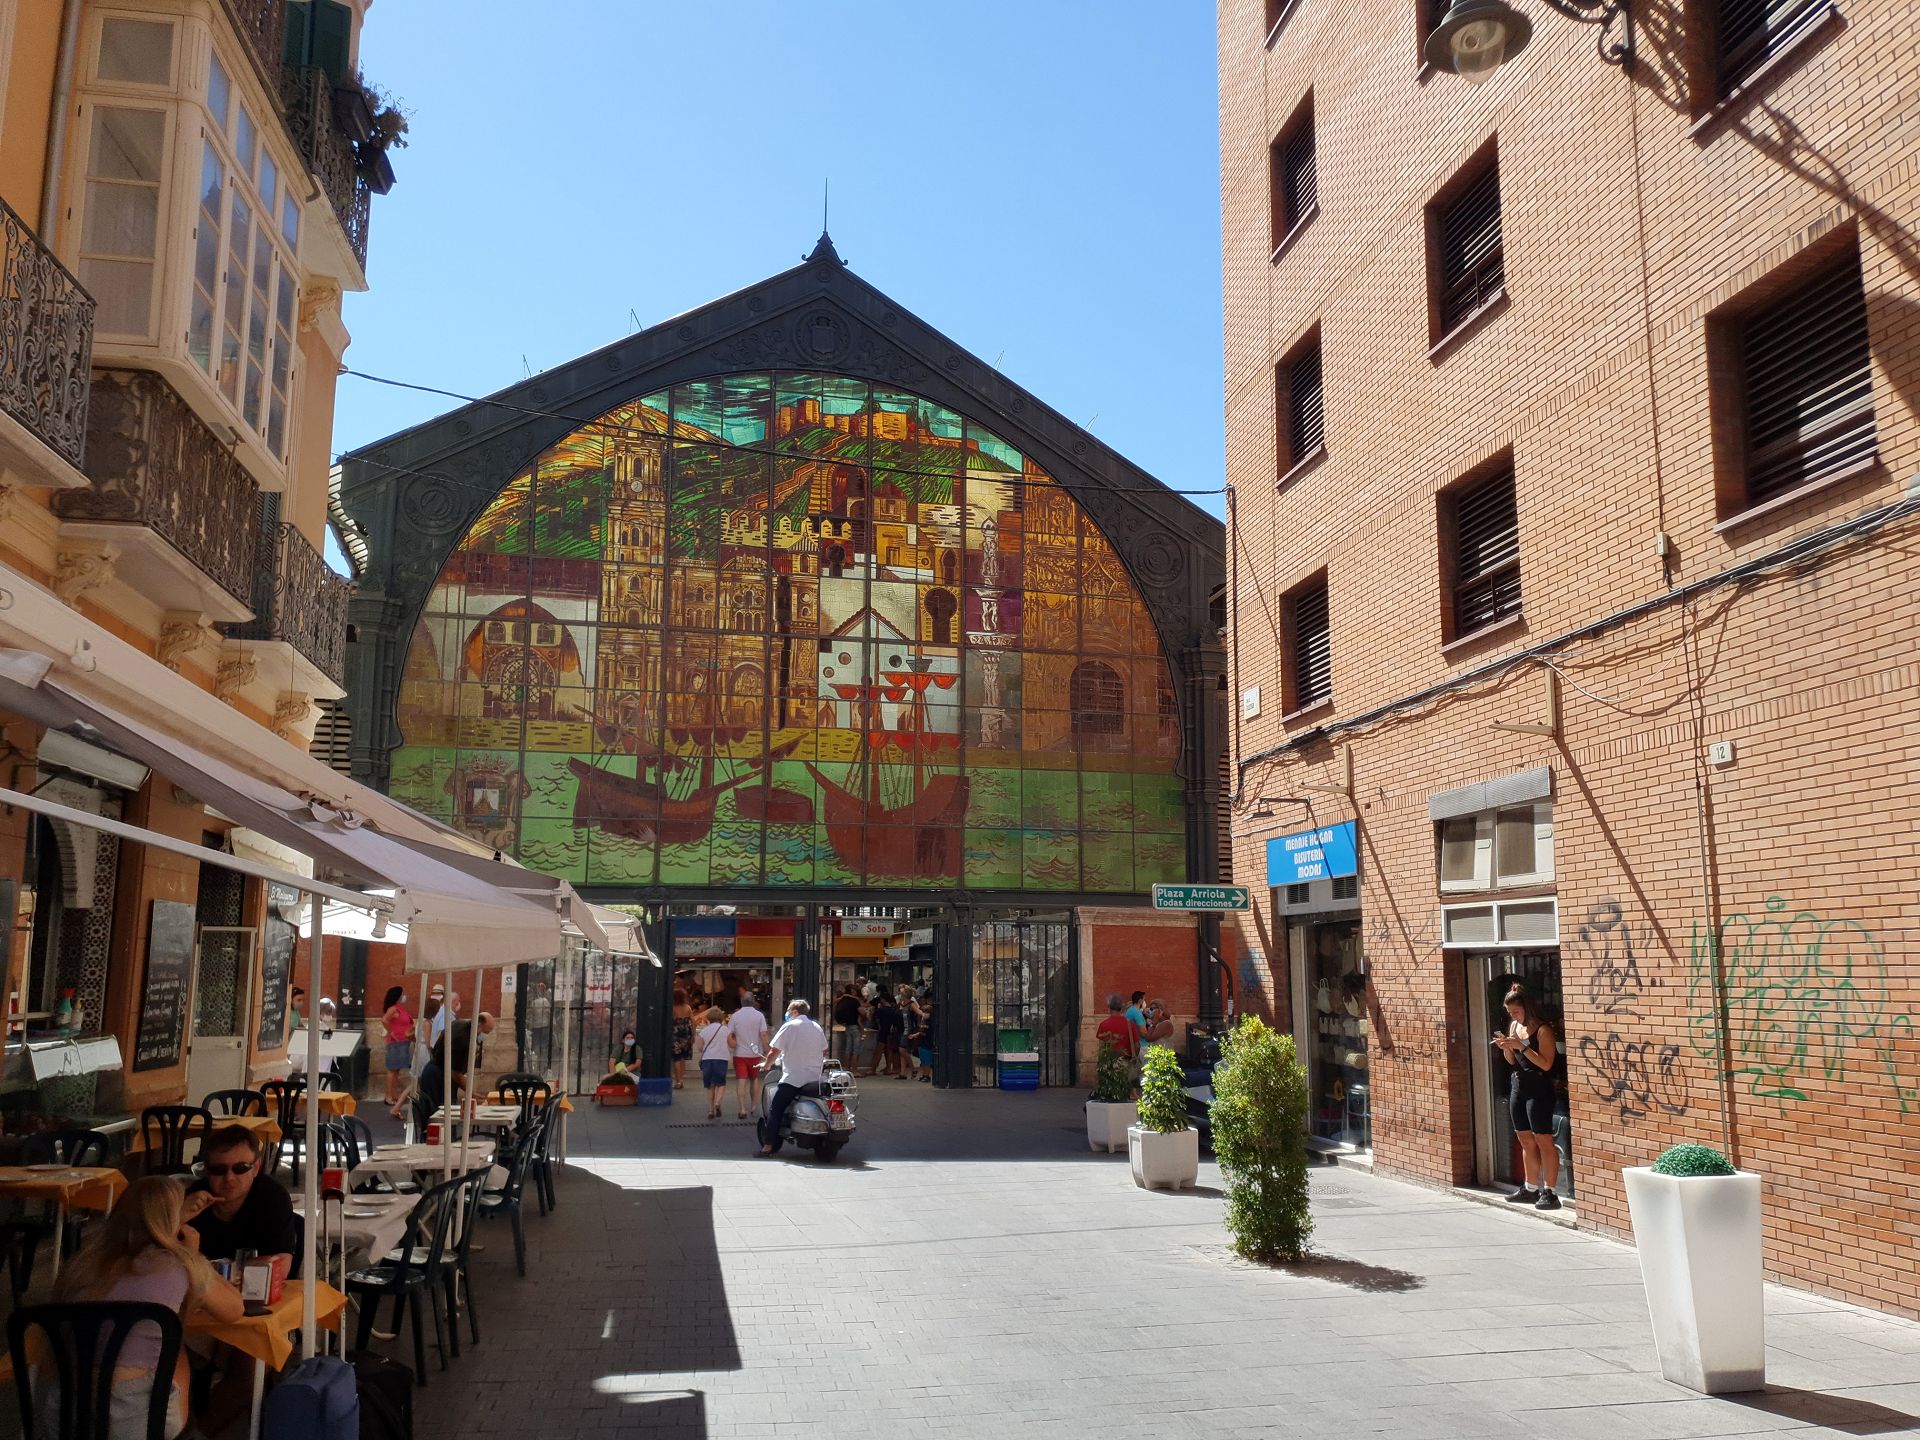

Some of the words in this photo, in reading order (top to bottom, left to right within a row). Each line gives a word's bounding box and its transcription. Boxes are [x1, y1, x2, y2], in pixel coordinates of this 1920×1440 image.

[1716, 746, 1725, 760] 12
[1286, 835, 1309, 851] MENAJE
[1309, 830, 1333, 847] HOGAR
[1297, 863, 1322, 879] MODAS
[1157, 888, 1184, 898] Plaza
[1191, 889, 1226, 899] Arriola
[1158, 898, 1183, 907] Todas
[1185, 899, 1233, 908] direcciones
[866, 924, 887, 933] Soto
